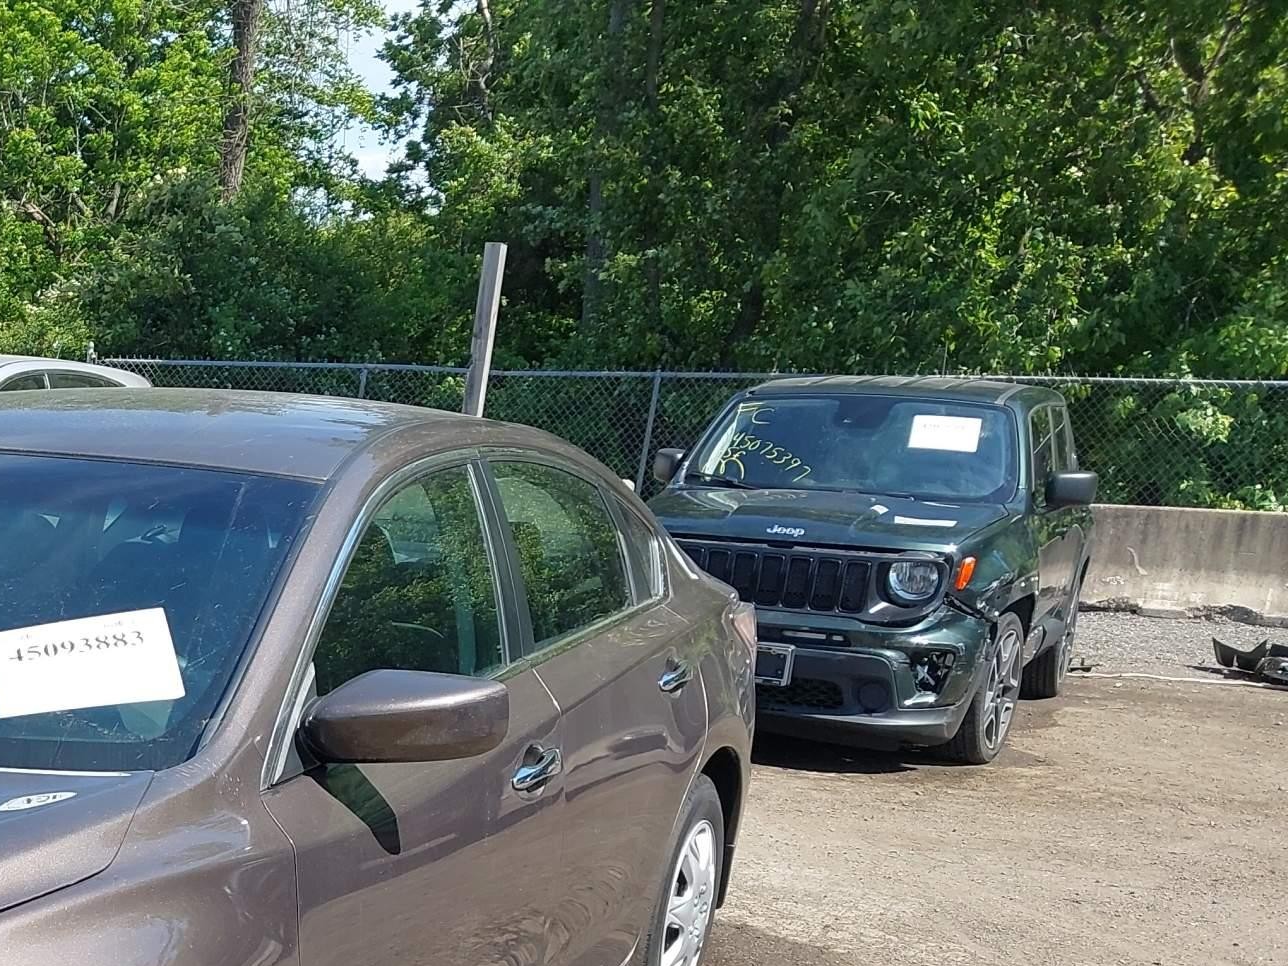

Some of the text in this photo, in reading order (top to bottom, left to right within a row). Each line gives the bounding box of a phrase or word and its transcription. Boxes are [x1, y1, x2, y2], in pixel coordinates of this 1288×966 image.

[732, 432, 812, 482] 45075397
[766, 524, 805, 538] Jeep
[9, 630, 145, 662] 45093883
